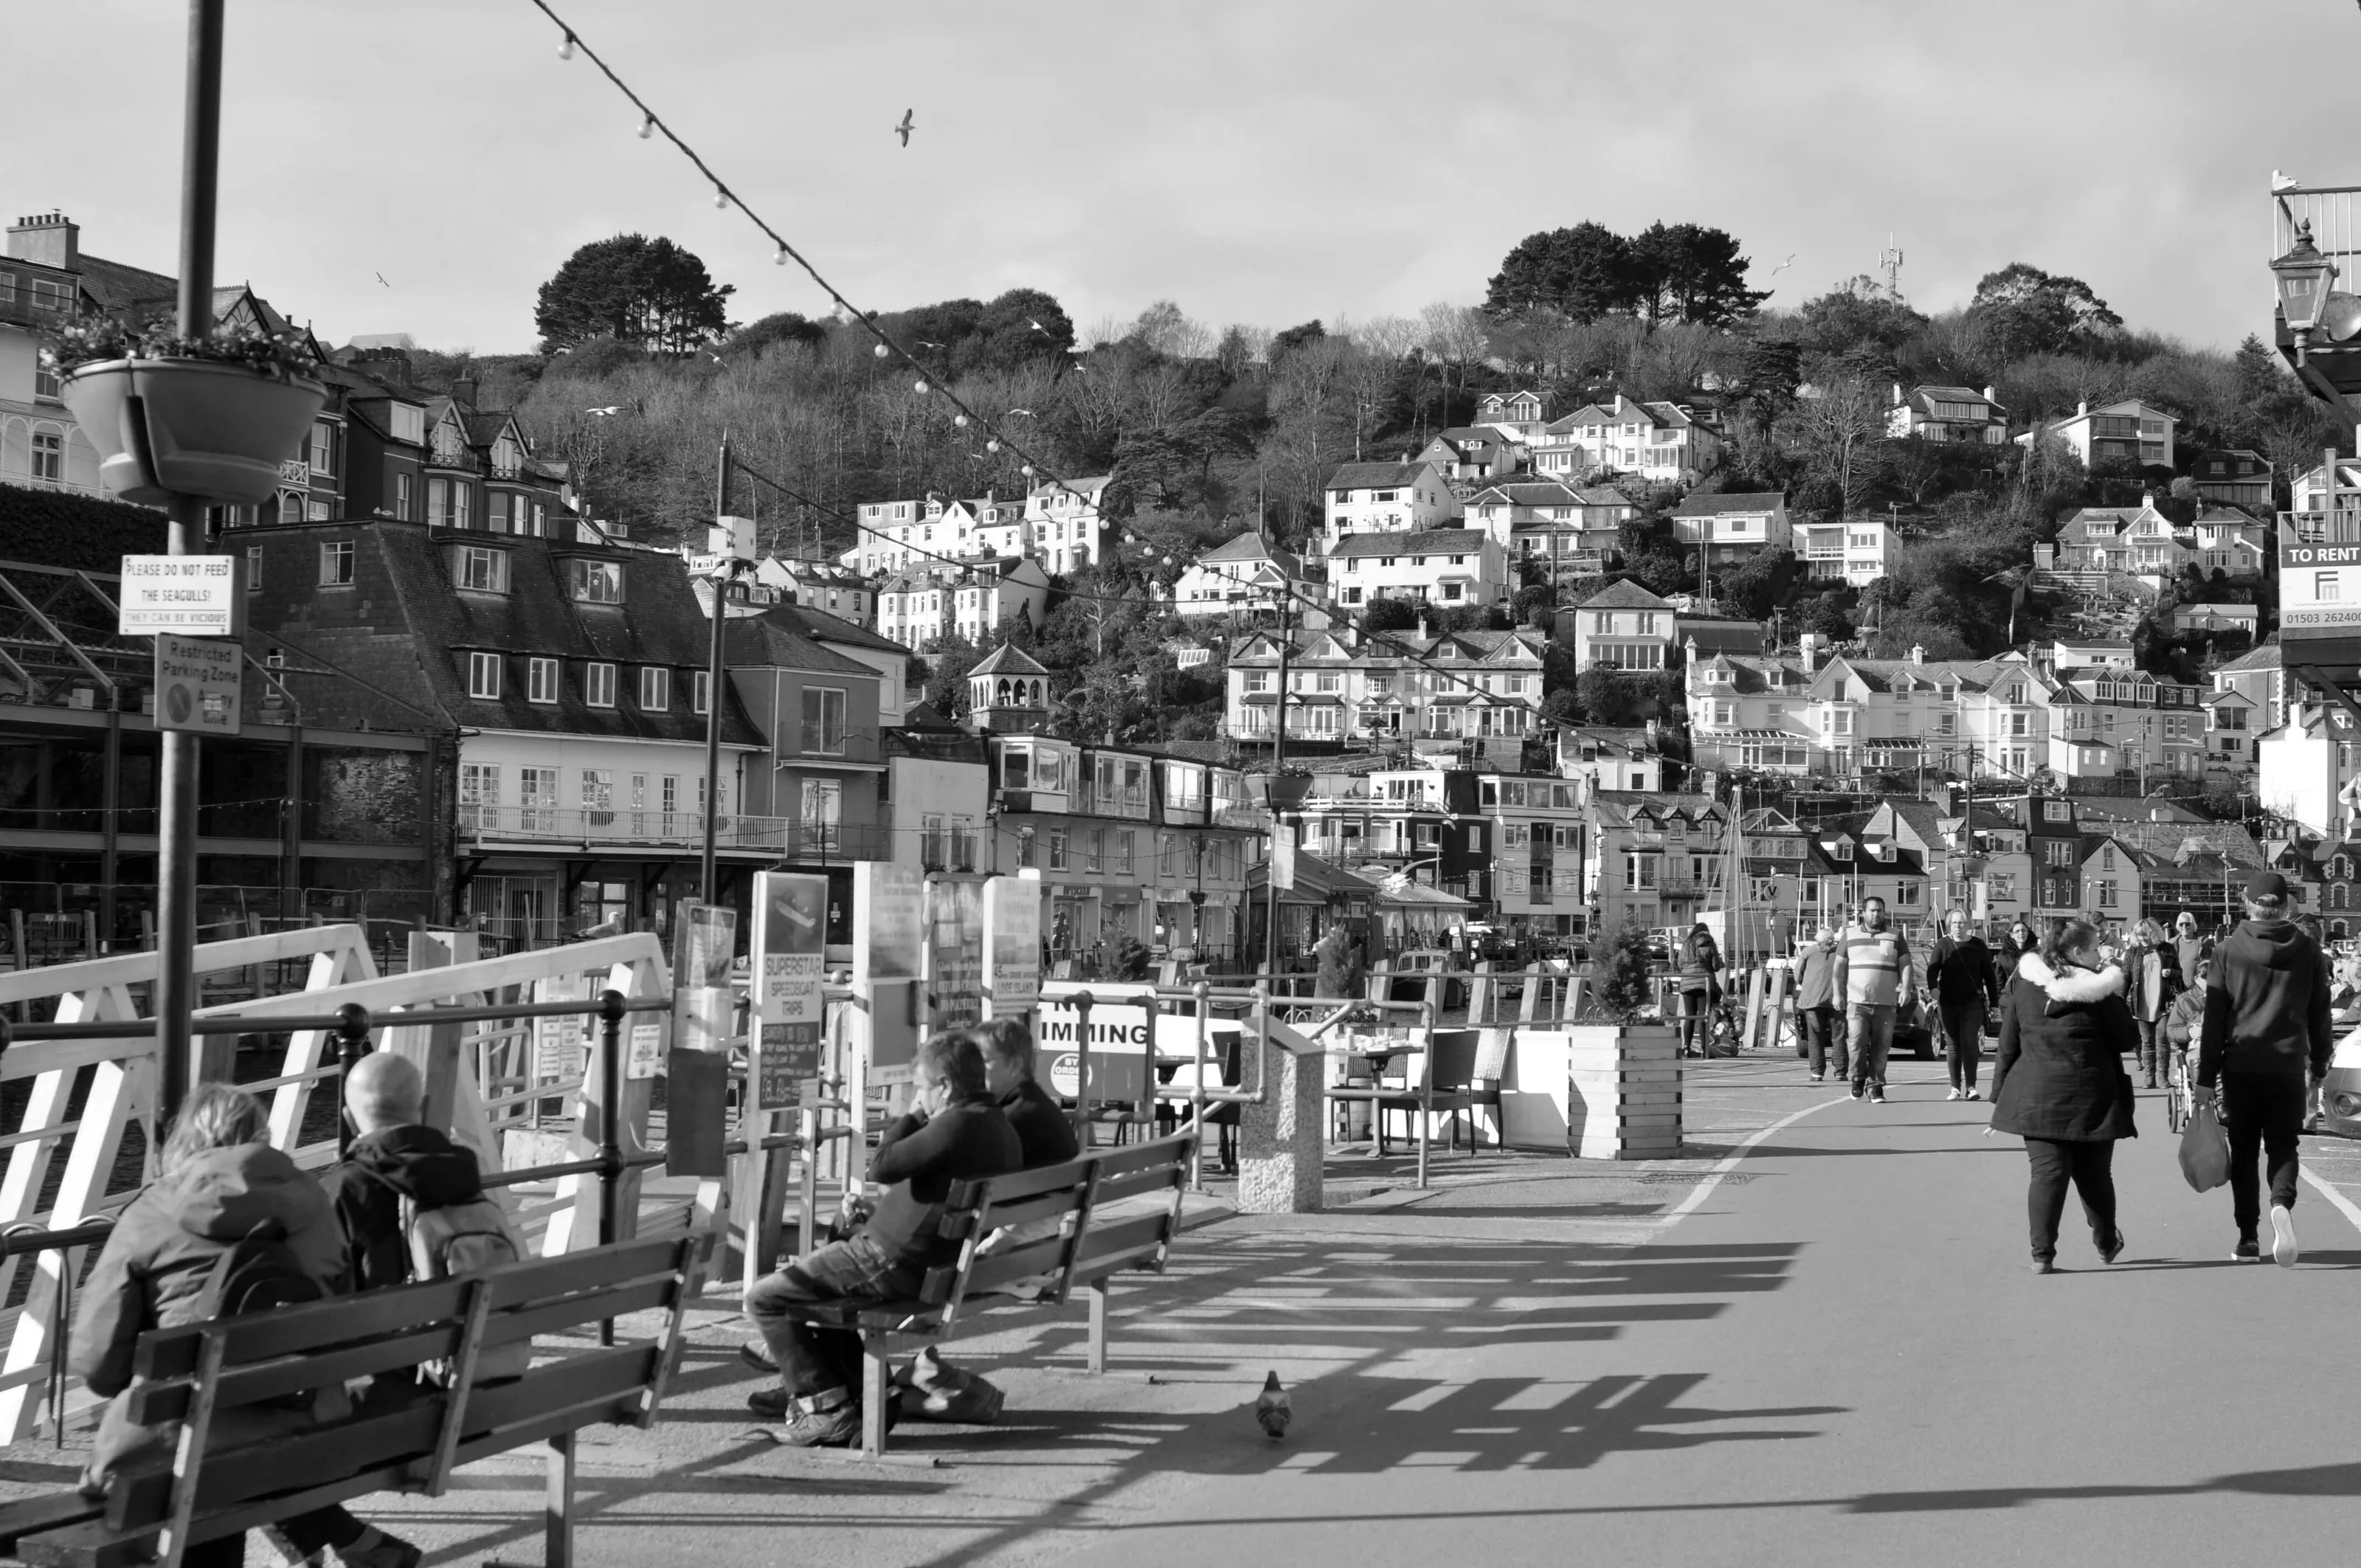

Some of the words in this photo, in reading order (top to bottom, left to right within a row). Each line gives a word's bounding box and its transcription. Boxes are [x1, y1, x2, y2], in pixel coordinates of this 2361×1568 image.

[2289, 549, 2312, 562] TO
[2317, 548, 2360, 562] RENT
[126, 564, 160, 576] PLEASE
[165, 564, 177, 576] DO
[182, 564, 201, 576] NOT
[205, 564, 228, 576] FEED
[142, 590, 158, 601] THE
[125, 613, 147, 622] THEY
[152, 613, 170, 622] CAN
[174, 613, 185, 622] BE
[190, 613, 227, 622] VICIOUS
[2287, 614, 2320, 624] 01503
[170, 641, 232, 663] Restricted
[162, 660, 207, 683] Parking
[211, 666, 238, 683] Zone
[766, 956, 821, 976] SUPERSTAR
[771, 981, 815, 997] SPEEDBOAT
[782, 1001, 803, 1016] TRIPS
[1042, 1022, 1147, 1044] IMMING
[1065, 1057, 1079, 1066] BY
[1055, 1066, 1079, 1074] ORDE
